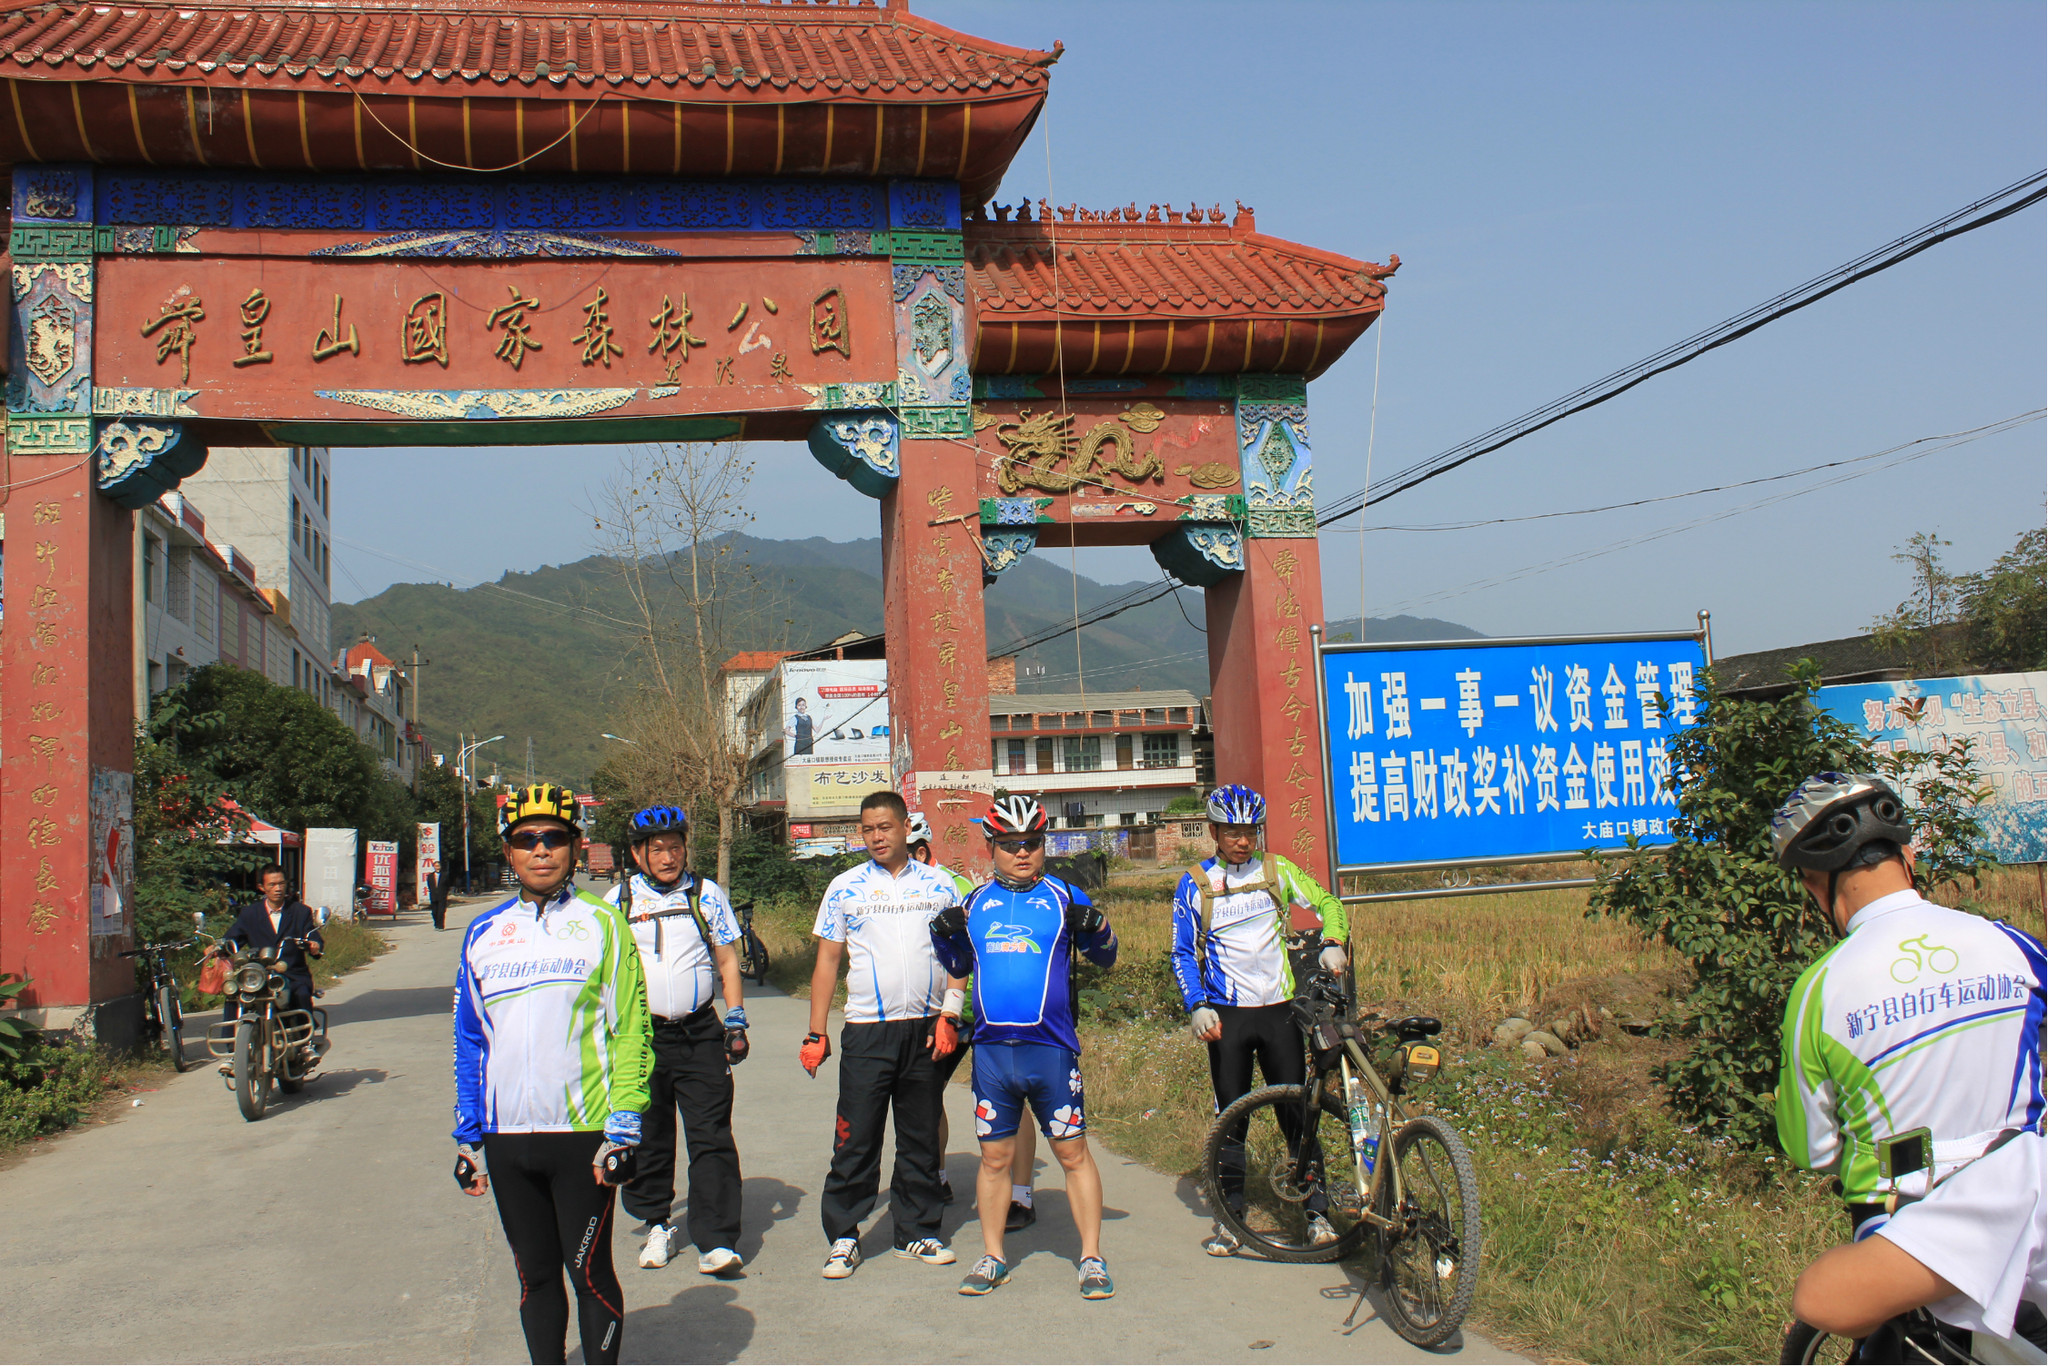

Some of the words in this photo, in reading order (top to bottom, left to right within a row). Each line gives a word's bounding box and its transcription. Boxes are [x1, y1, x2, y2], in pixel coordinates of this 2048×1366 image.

[1343, 660, 1698, 741] 加强一事一议资金管理
[814, 769, 889, 785] 布艺沙发
[1349, 737, 1700, 823] 提高财政奖补资金使用效
[856, 902, 939, 917] 新宁县自行车运动协会
[482, 957, 586, 979] 新宁县自行车运动协会
[1845, 974, 2027, 1039] 新宁县自行车运动协会
[574, 1216, 598, 1268] JAKROO
